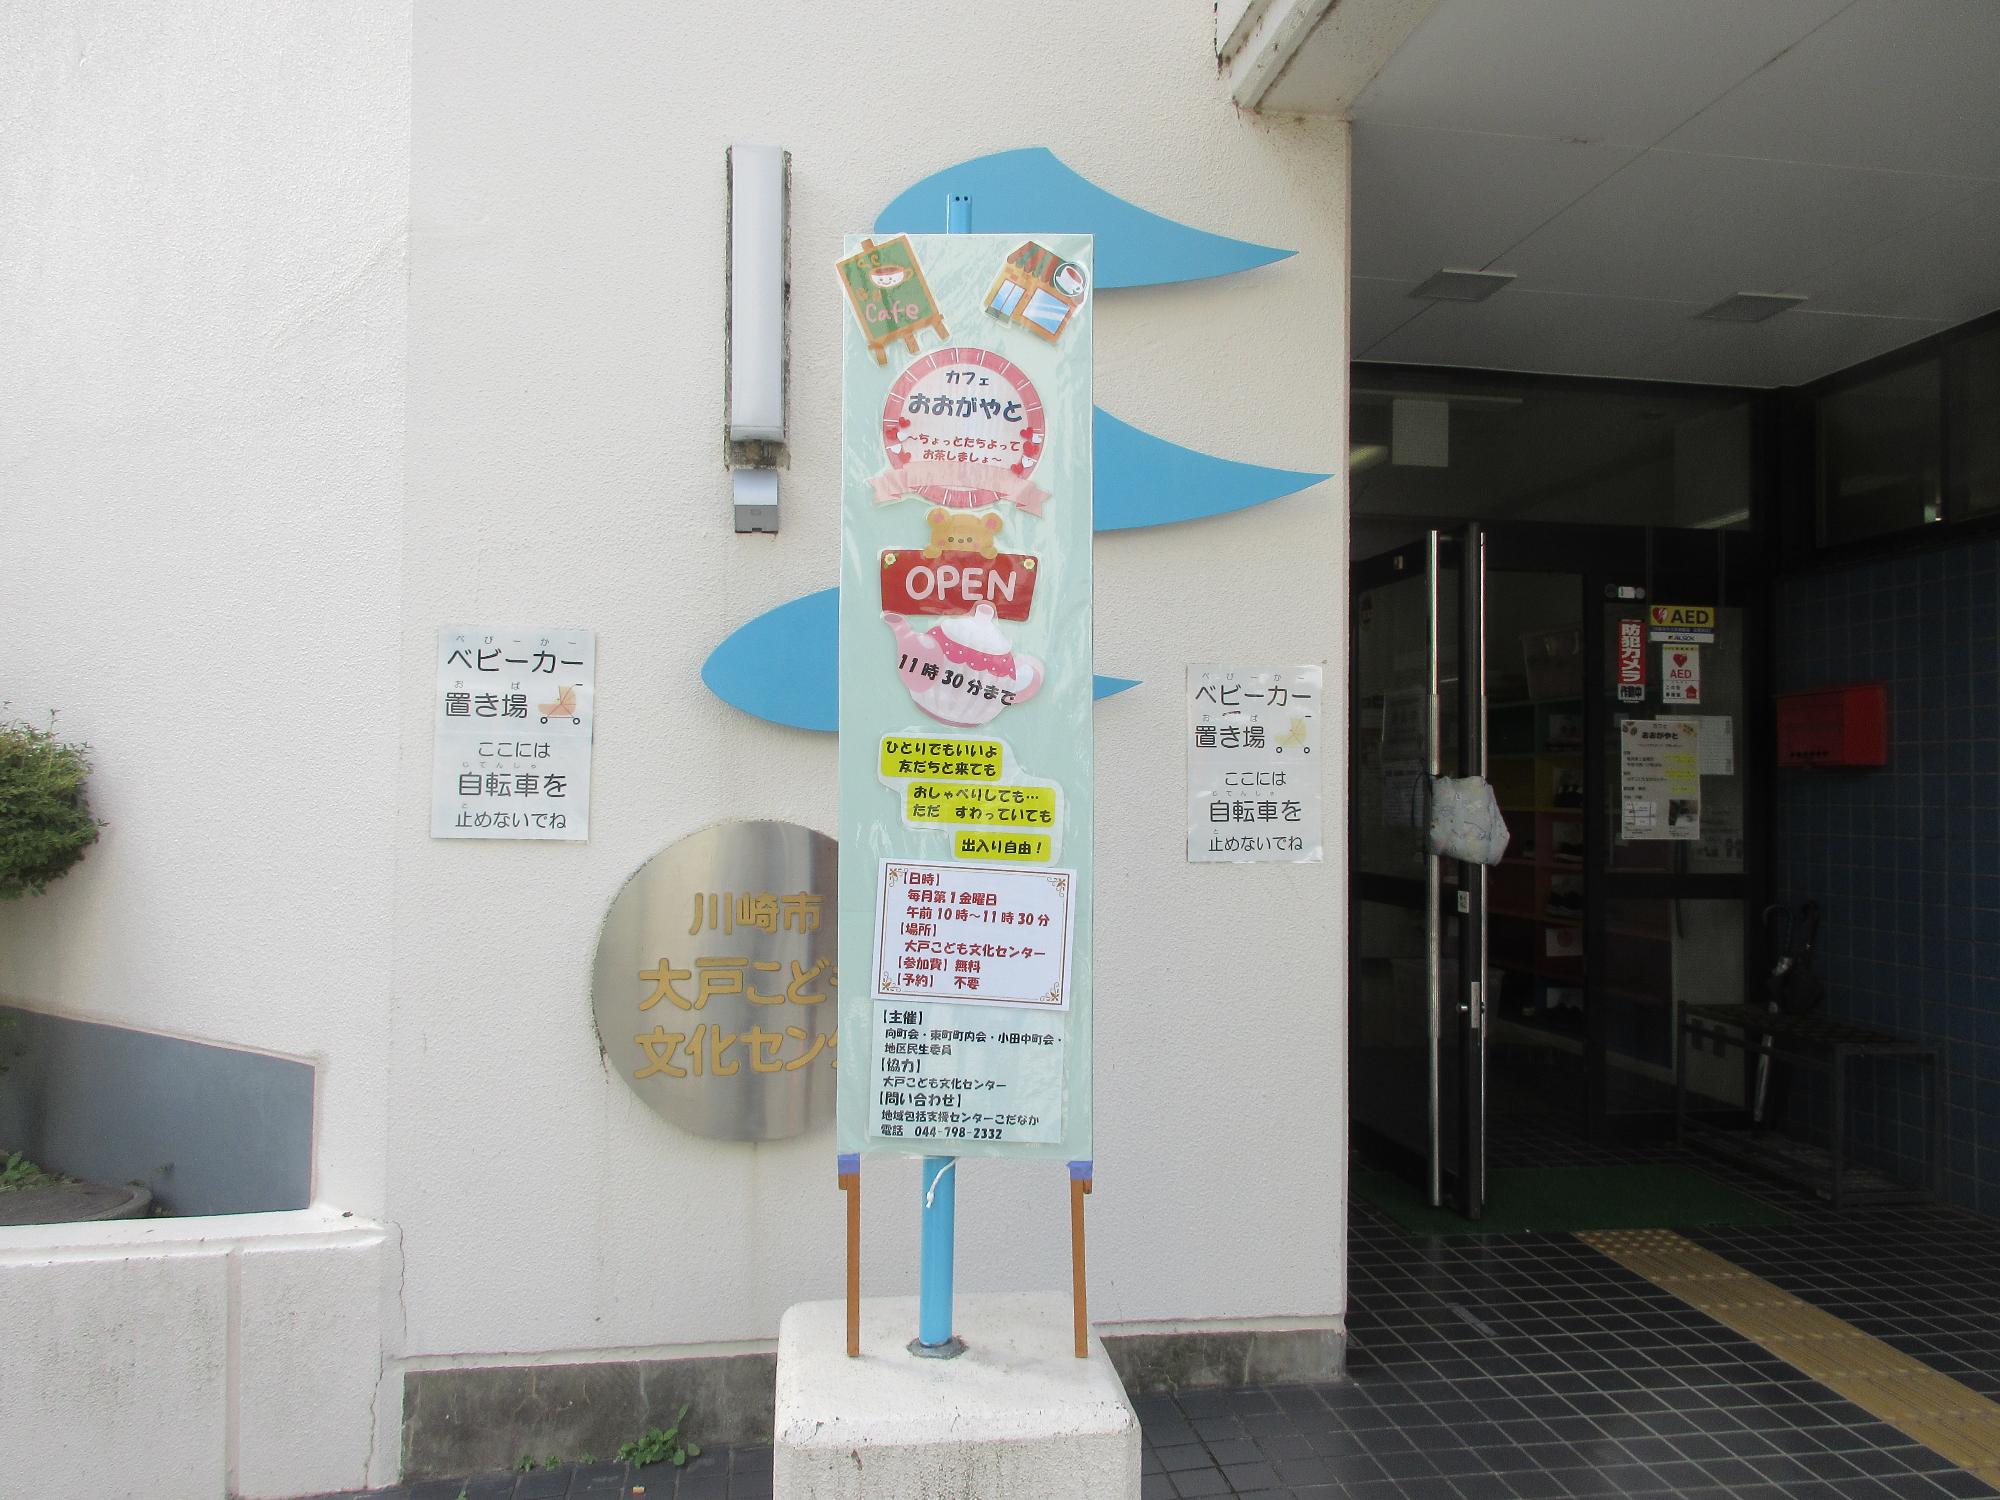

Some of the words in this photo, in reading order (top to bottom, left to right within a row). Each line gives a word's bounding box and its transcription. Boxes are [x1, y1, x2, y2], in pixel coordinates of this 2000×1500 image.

[865, 301, 920, 323] Cafe
[946, 370, 989, 386] カフェ
[908, 393, 1022, 422] おおがやと
[906, 565, 1017, 601] OPEN
[1670, 610, 1709, 624] AED
[447, 648, 583, 673] ベビーカー
[1622, 623, 1641, 682] 防犯カメラ
[1670, 669, 1692, 679] AED
[1195, 684, 1311, 706] ベビーカー
[445, 692, 527, 718] 置き場
[1195, 725, 1265, 748] 置き場
[478, 742, 550, 758] ここには
[886, 740, 997, 758] ひとりでもいいよ
[898, 759, 996, 776] 友だちと来ても
[459, 771, 567, 797] 自転車を
[1225, 771, 1287, 786] ここには
[455, 811, 566, 829] 止めないでね
[913, 804, 940, 818] ただ
[955, 806, 1052, 823] すわっていても
[1210, 800, 1301, 822] 自転車を
[1209, 836, 1303, 851] 止めないでね
[907, 889, 997, 906] 毎月第1金曜日
[689, 892, 824, 935] 川崎市
[904, 940, 1046, 959] 大戸こども文化センター
[639, 956, 838, 1011] 大戸こど
[954, 976, 980, 990] 不要
[885, 1043, 952, 1056] 地区民生委員
[883, 1076, 1007, 1091] 大戸こども文化センター
[881, 1109, 1040, 1126] 地域包括支援センターこだなか
[881, 1124, 903, 1137] 電話
[914, 1126, 1003, 1140] 044-798-2332
